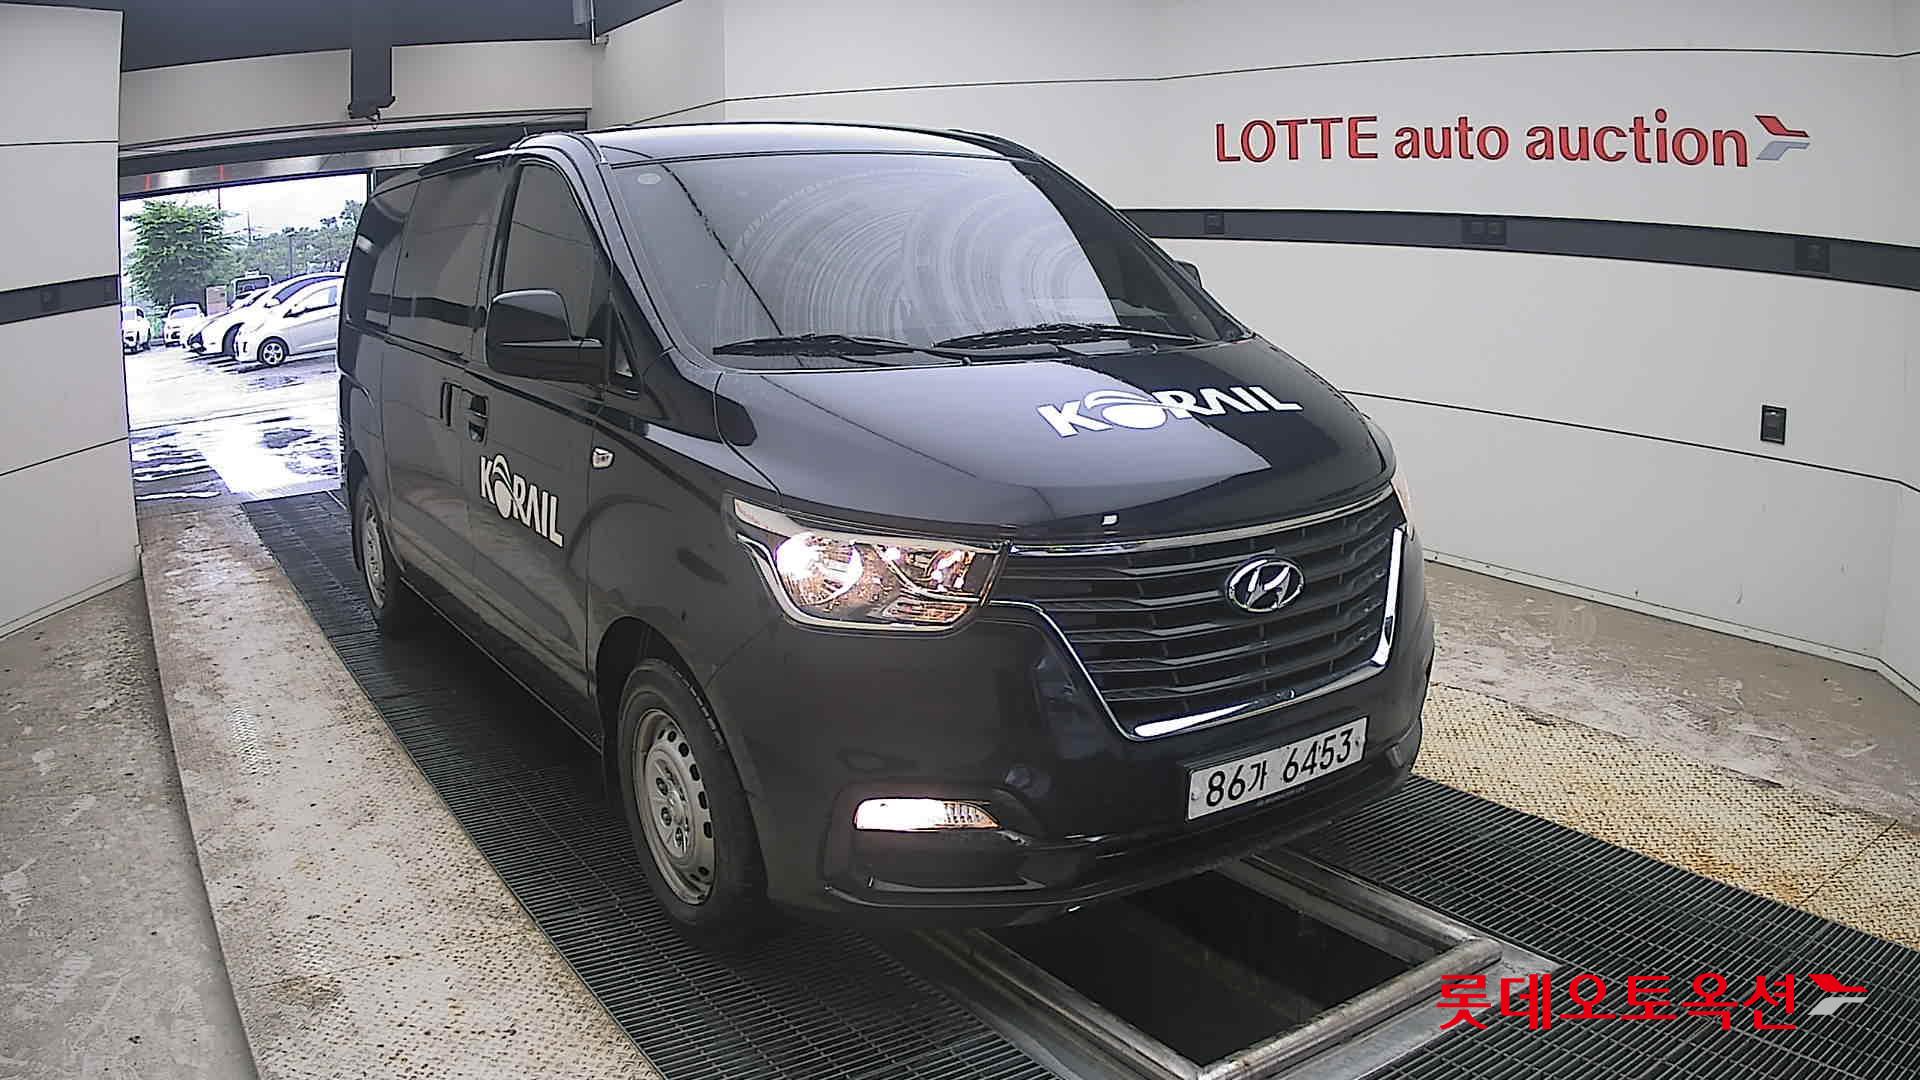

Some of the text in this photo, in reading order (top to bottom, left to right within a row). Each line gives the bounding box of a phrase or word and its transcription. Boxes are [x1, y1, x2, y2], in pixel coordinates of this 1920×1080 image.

[1215, 108, 1749, 168] LOTTE auto auction
[1037, 386, 1304, 438] KORAIL
[480, 454, 564, 547] KORAIL
[1206, 728, 1353, 807] 86가 6453
